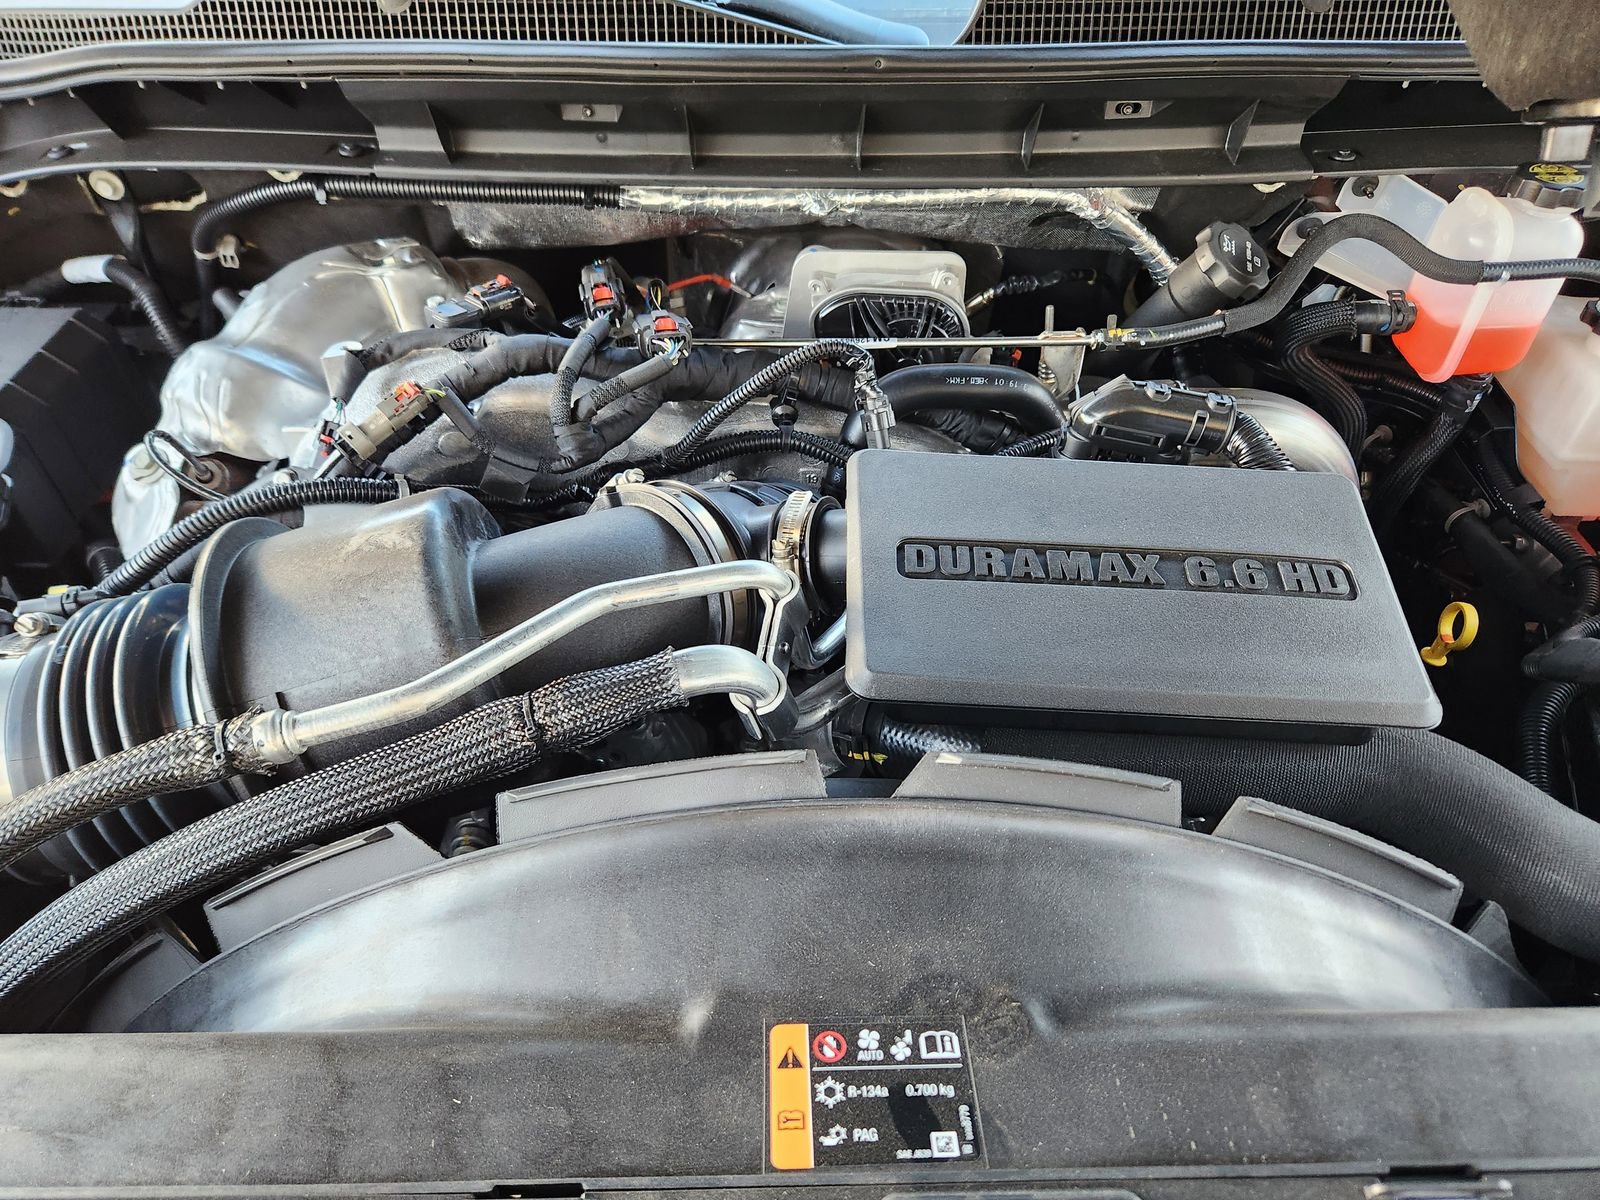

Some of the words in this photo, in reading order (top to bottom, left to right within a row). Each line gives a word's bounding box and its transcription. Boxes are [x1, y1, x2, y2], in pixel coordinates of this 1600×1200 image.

[903, 543, 1166, 586] DURAMAX
[1182, 554, 1269, 591] 6.6
[1278, 561, 1351, 596] HD
[857, 1049, 884, 1061] AUTO
[847, 1085, 890, 1098] R-134a
[904, 1083, 938, 1097] 0.700
[939, 1083, 955, 1098] kg
[852, 1127, 879, 1142] PAG
